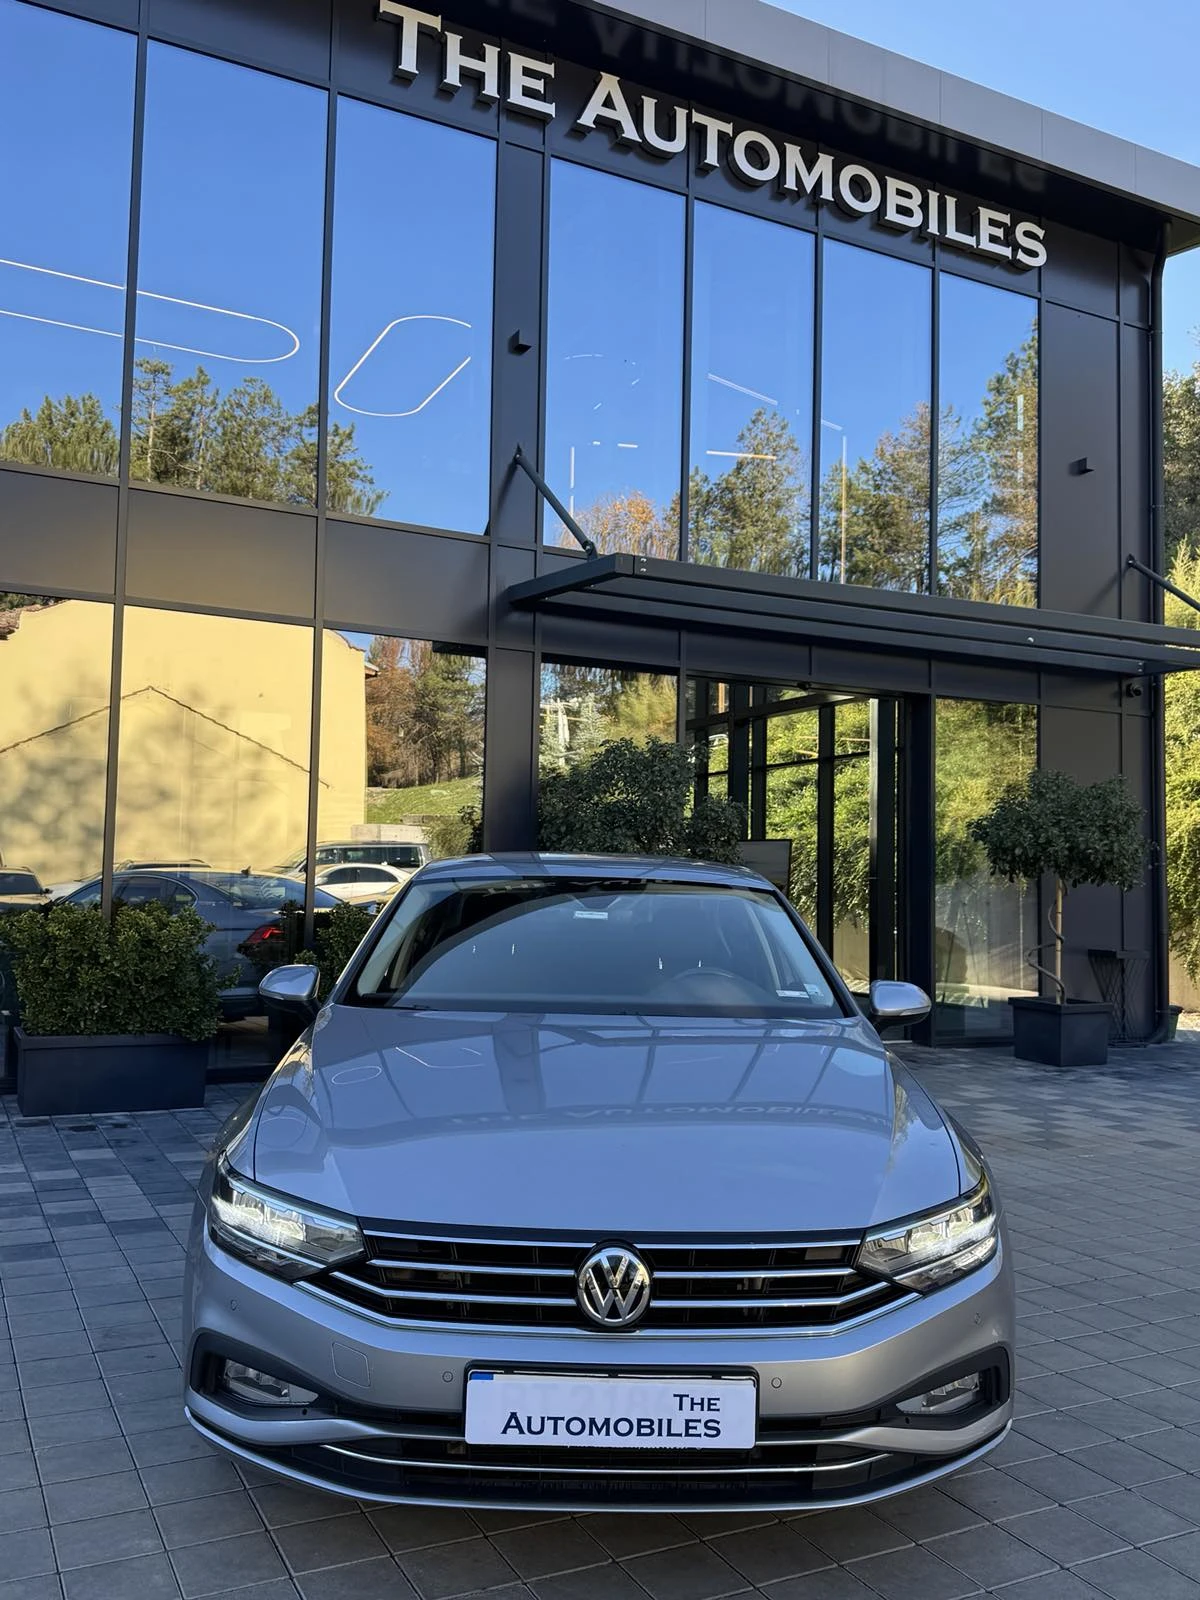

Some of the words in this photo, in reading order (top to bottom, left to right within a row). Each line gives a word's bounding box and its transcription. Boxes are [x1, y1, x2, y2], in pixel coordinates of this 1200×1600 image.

[379, 0, 556, 118] THE
[576, 71, 1048, 267] AUTOMOBILES
[578, 1247, 650, 1327] VW
[500, 1411, 722, 1439] AUTOMOBILES
[672, 1393, 721, 1412] THE
